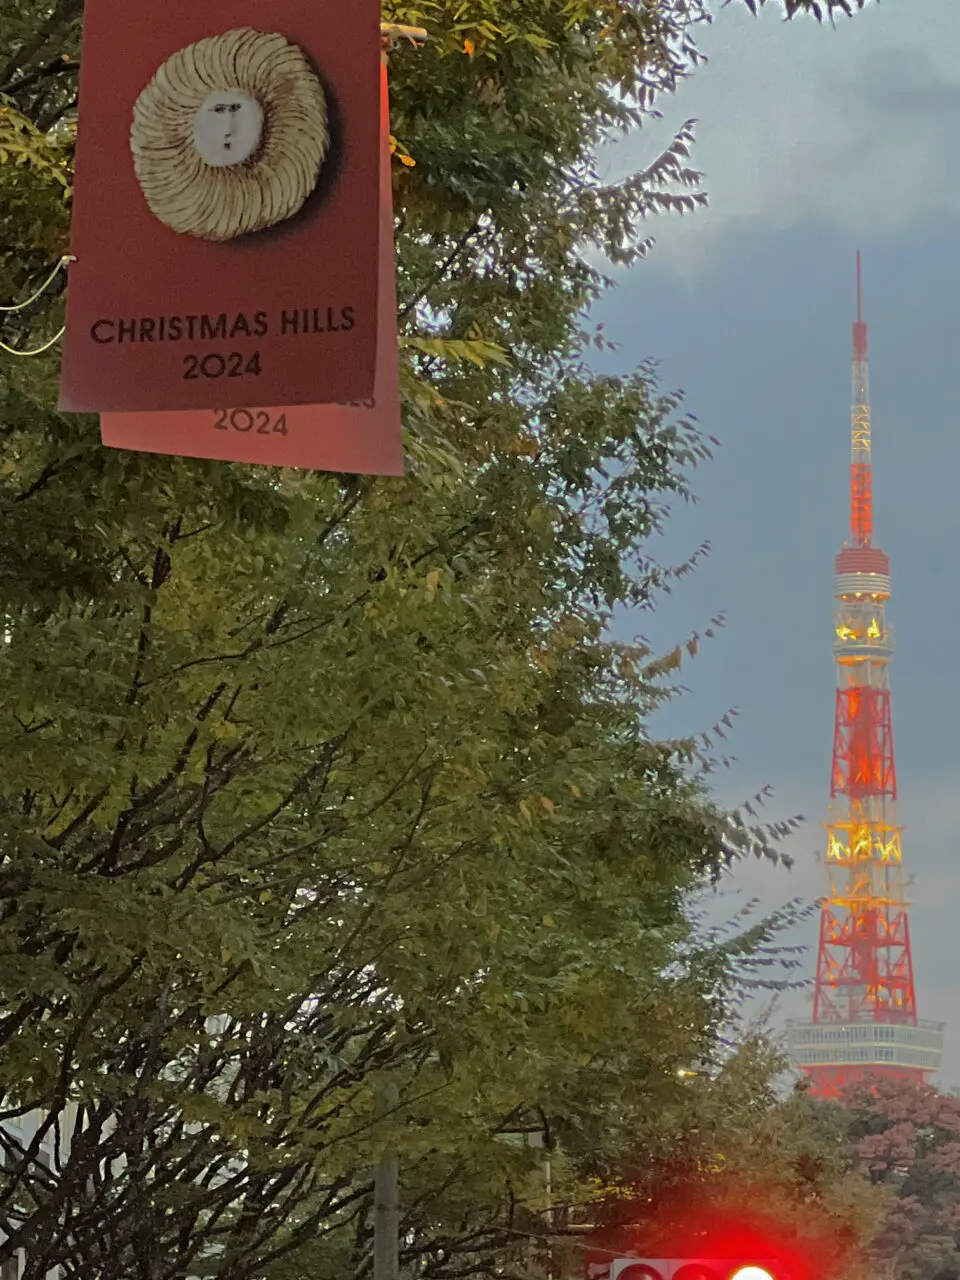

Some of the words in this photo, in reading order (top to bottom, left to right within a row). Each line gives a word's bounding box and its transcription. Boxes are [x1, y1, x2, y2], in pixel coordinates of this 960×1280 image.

[90, 311, 268, 345] CHRISTMAS
[280, 306, 357, 335] HILLS
[182, 351, 262, 380] 2024
[213, 408, 289, 436] 2024
